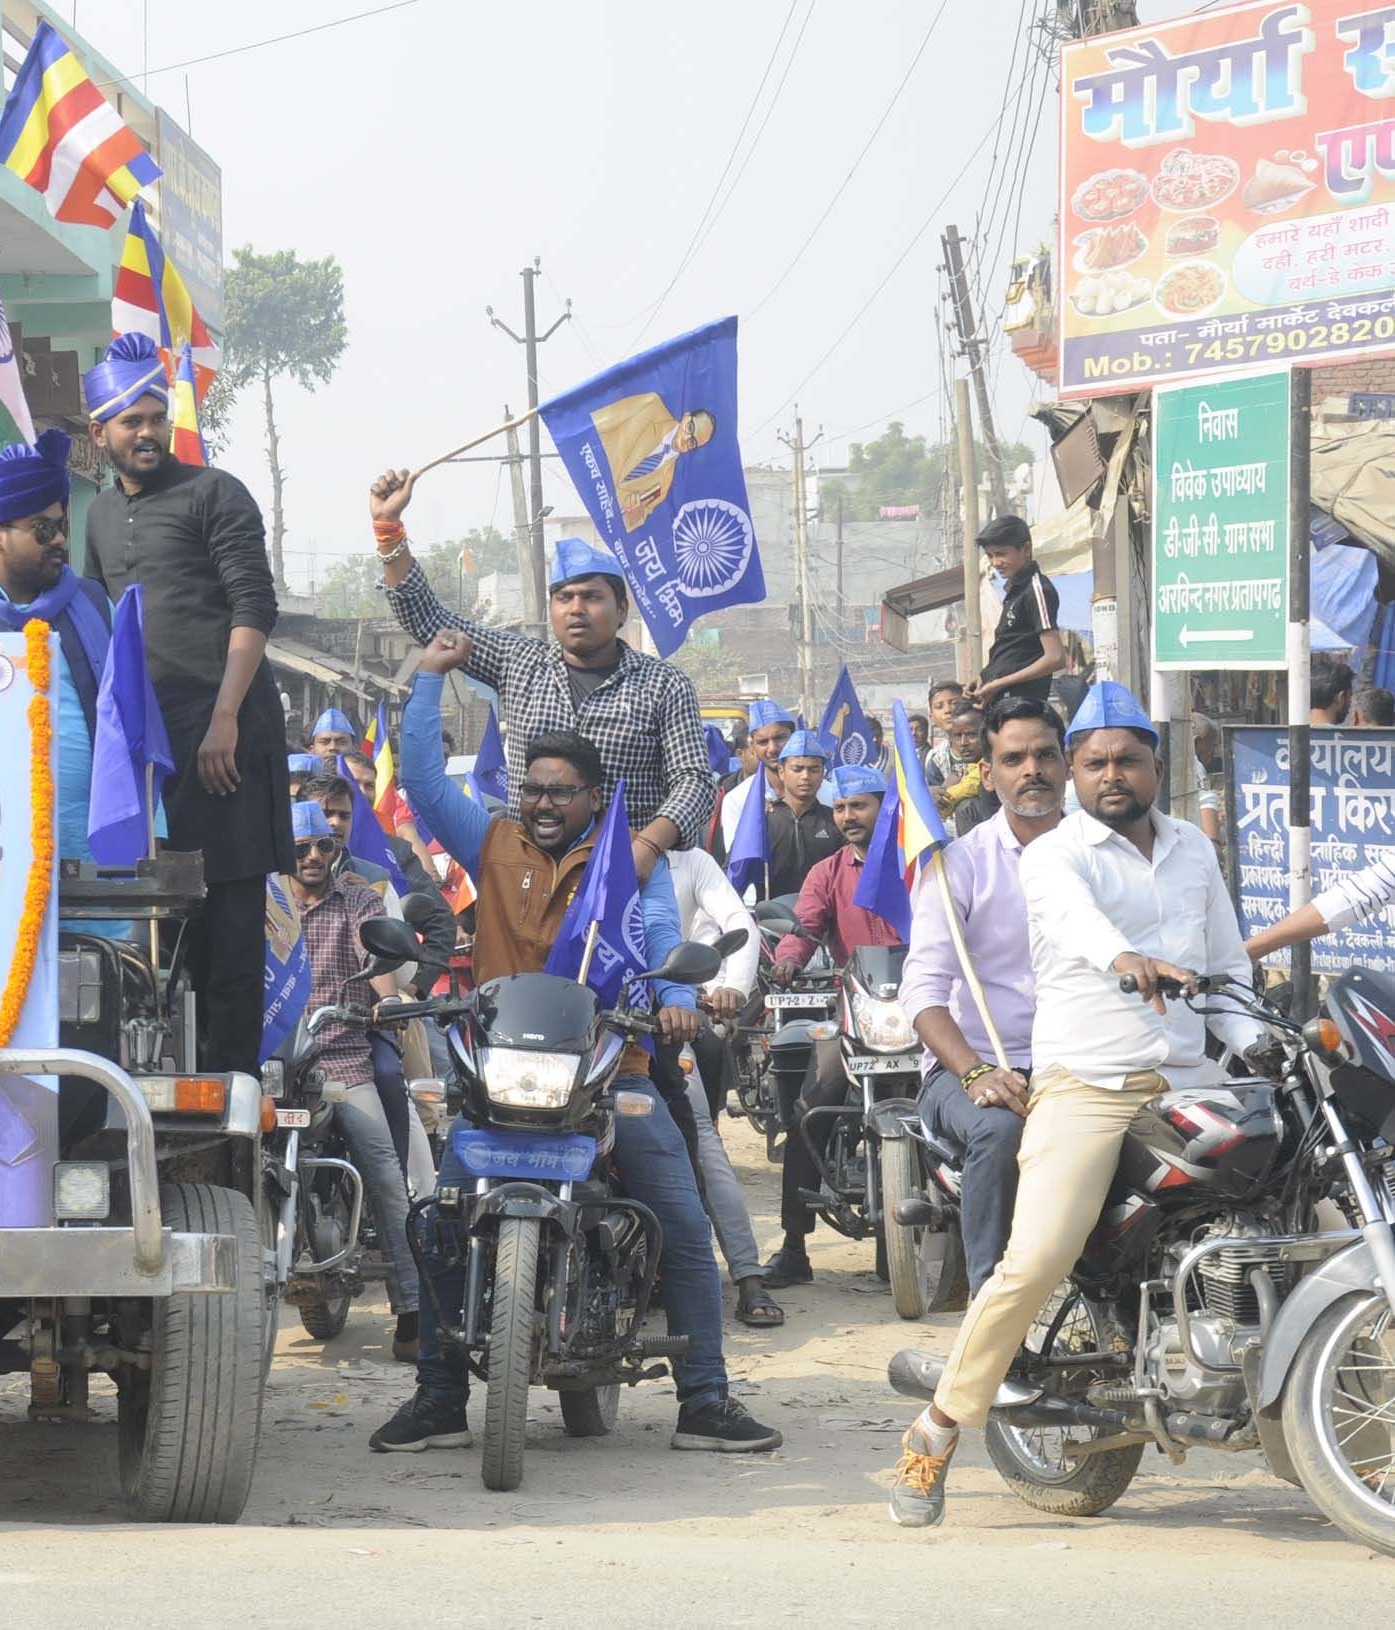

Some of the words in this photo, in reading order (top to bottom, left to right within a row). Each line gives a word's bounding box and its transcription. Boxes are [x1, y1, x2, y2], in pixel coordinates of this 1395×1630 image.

[1349, 207, 1389, 232] शादी
[1256, 305, 1320, 330] मार्केट
[1185, 315, 1395, 365] 7457902820
[1197, 400, 1239, 443] निवास
[1171, 459, 1208, 503] विवेक
[1209, 462, 1267, 498] उपाध्याय
[635, 536, 667, 582] जय
[1223, 522, 1248, 555] ग्राम
[1248, 520, 1275, 553] सभा
[1158, 572, 1203, 615] अरविन्द
[1204, 580, 1231, 612] नगर
[1247, 831, 1285, 863] हिन्दी
